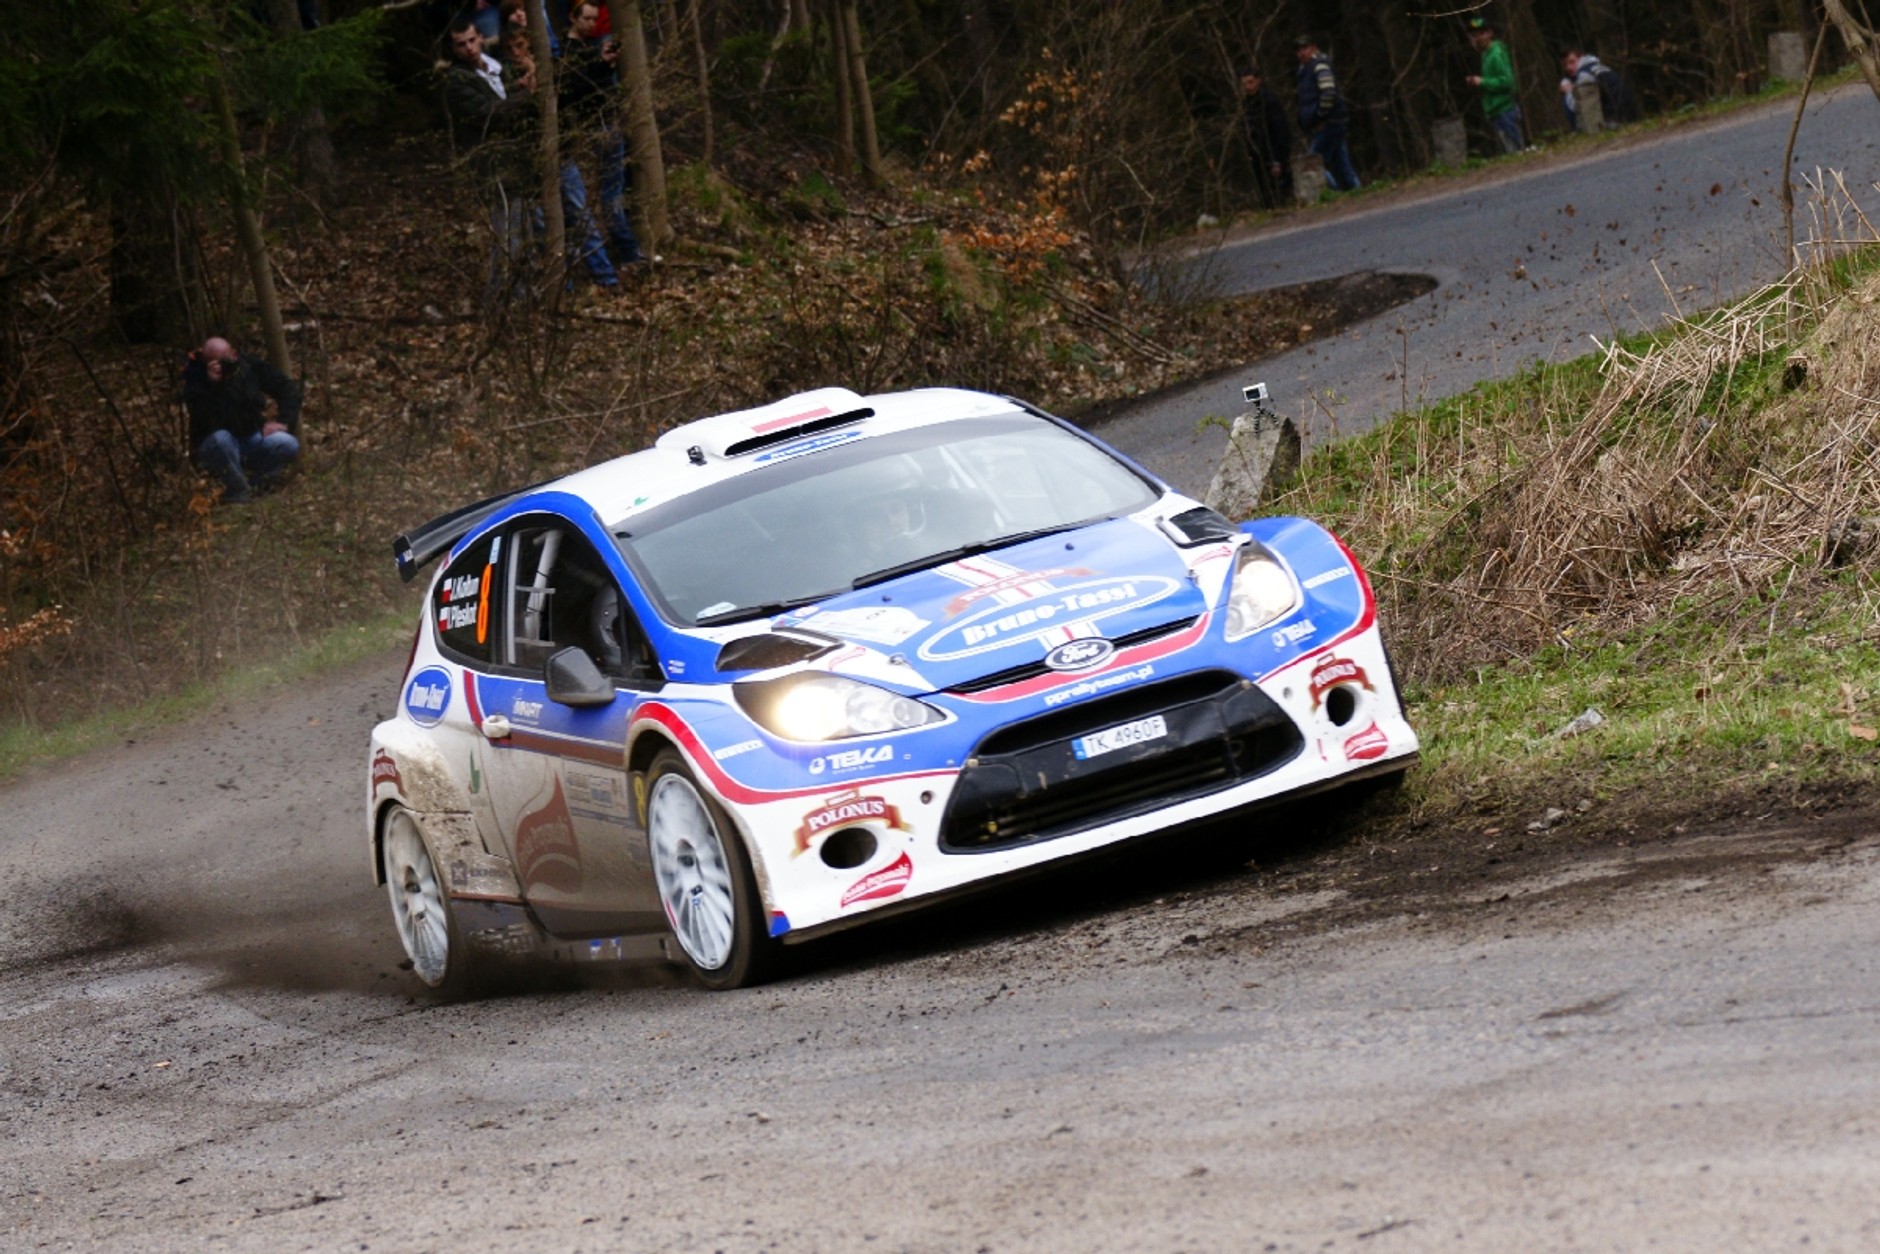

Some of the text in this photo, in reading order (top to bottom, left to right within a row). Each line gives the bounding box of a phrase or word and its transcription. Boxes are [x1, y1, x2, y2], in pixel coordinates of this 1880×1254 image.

[477, 563, 493, 644] 8
[961, 582, 1138, 646] Bruno-Tassi
[1060, 643, 1101, 664] Ford
[1086, 718, 1162, 754] TK 4960F
[826, 744, 894, 770] TEKA
[808, 800, 886, 832] POLONUS
